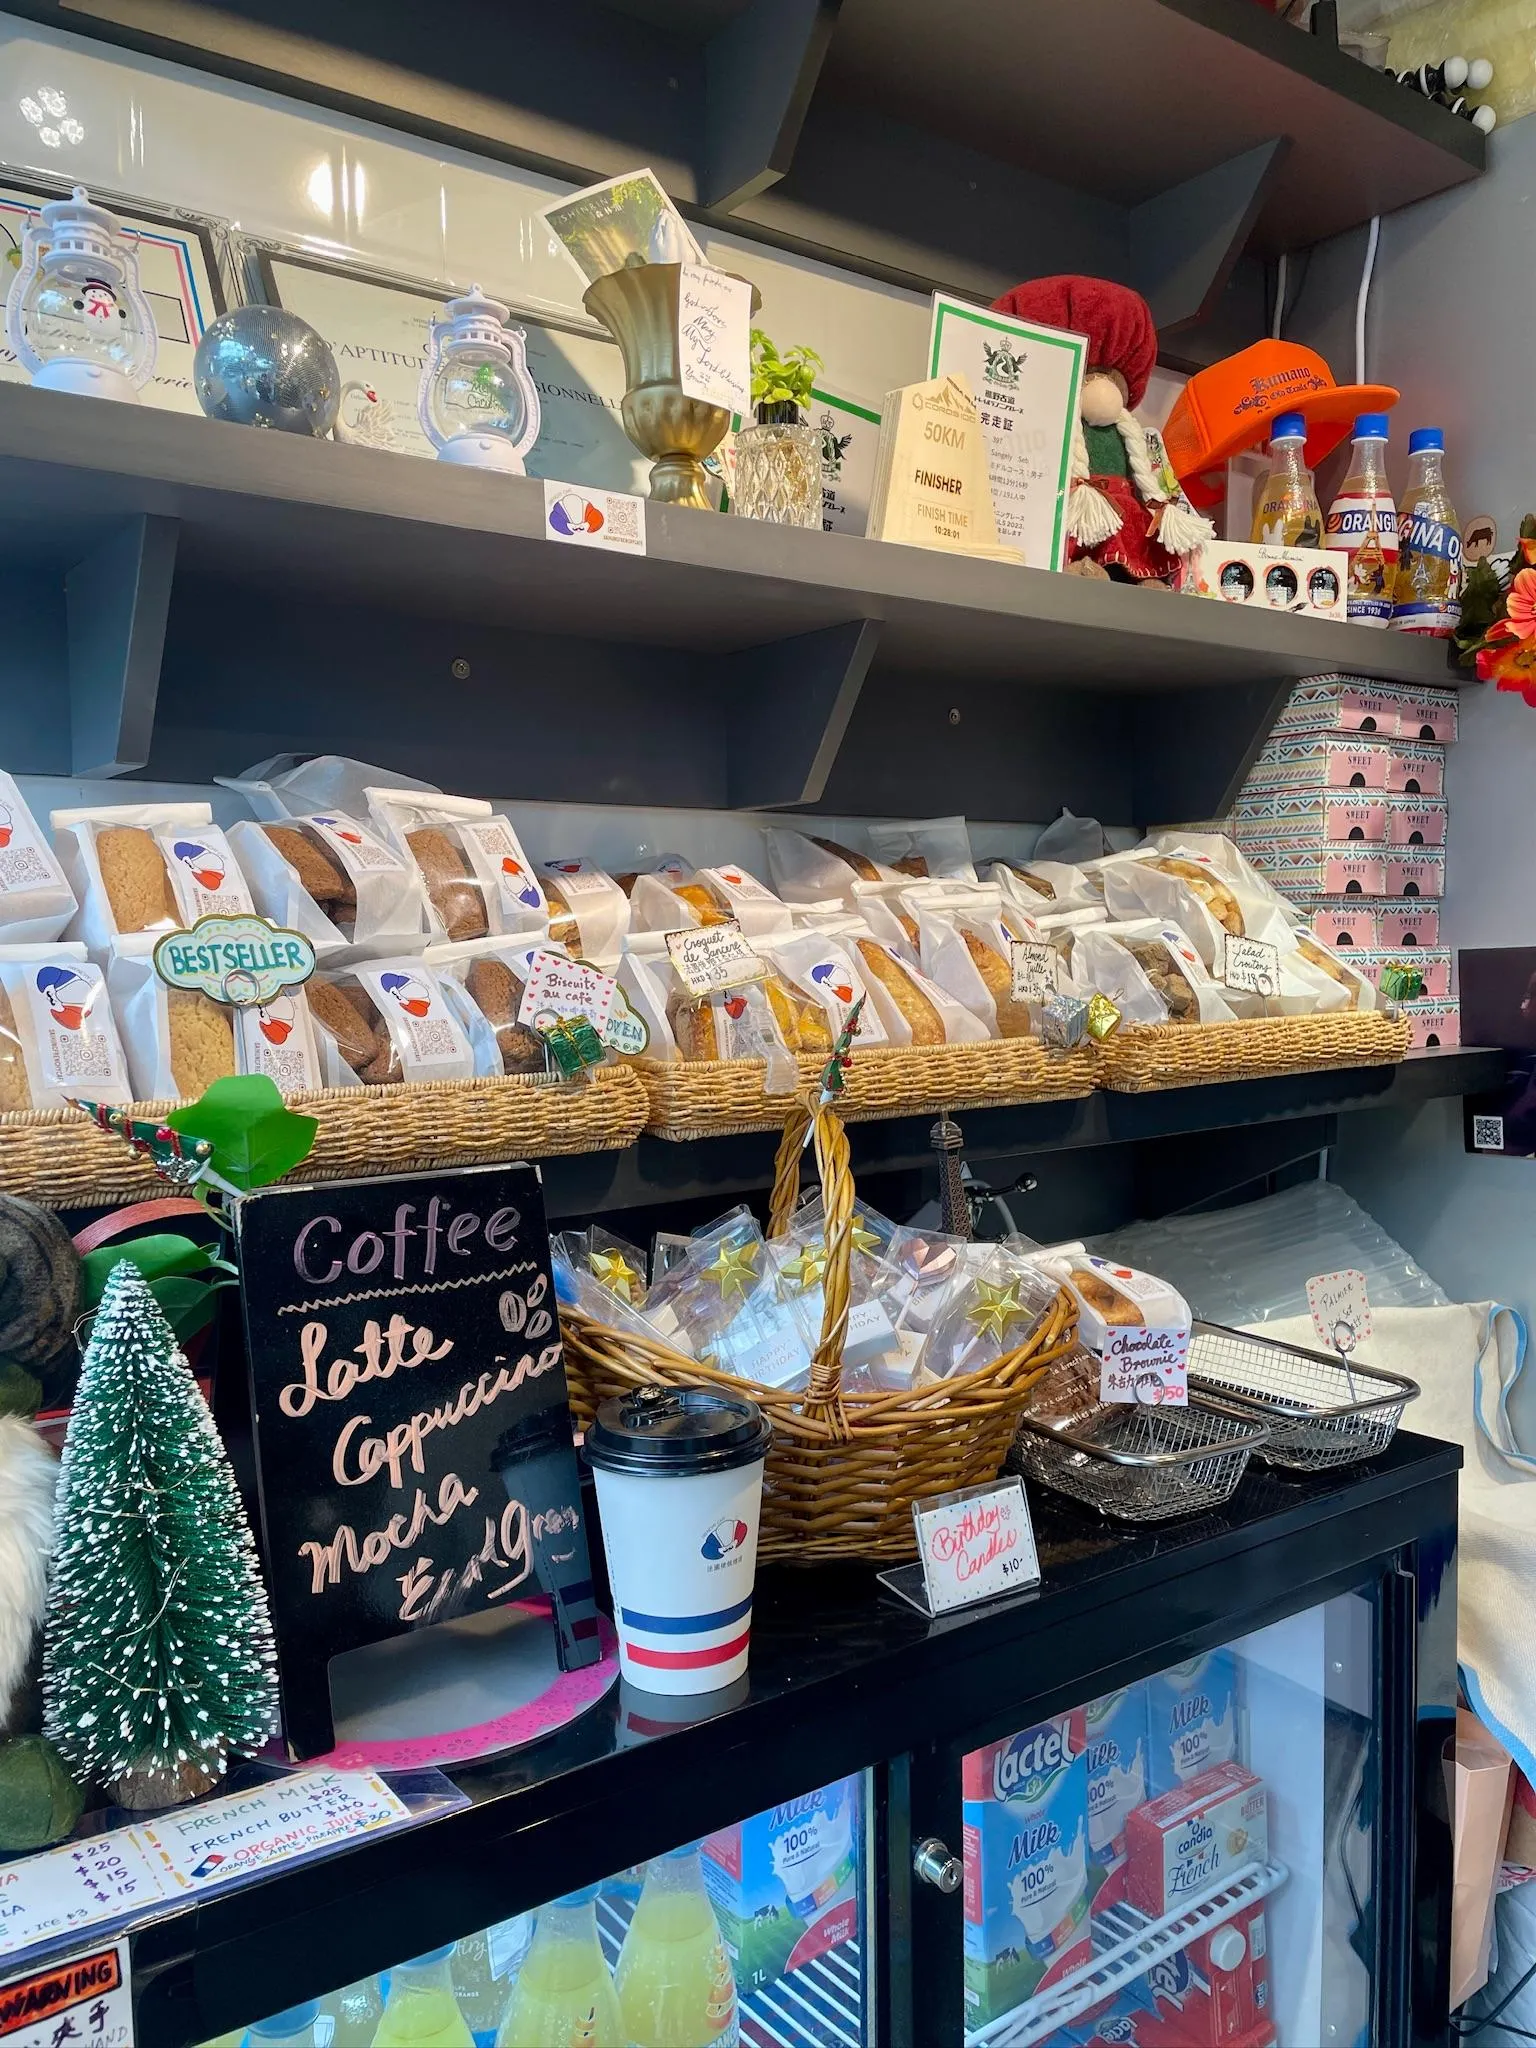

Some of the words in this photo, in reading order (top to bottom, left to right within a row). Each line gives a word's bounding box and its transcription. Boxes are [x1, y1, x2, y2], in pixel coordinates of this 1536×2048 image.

[980, 412, 1014, 432] 完走証
[924, 420, 966, 451] 50KM
[914, 469, 963, 496] FINISHER
[917, 503, 946, 524] FINISH
[948, 510, 968, 528] TIME
[1342, 512, 1397, 534] ORANGI
[934, 524, 960, 540] 10:28:01
[1359, 700, 1382, 711] SWEET
[1416, 709, 1438, 720] SWEET
[1347, 756, 1372, 766] SWEET
[1403, 764, 1425, 773] SWEET
[1346, 811, 1369, 820] SWEET
[1407, 815, 1429, 825] SWEET
[1343, 864, 1366, 873] SWEET
[1401, 867, 1424, 877] SWEET
[1332, 917, 1356, 926] SWEET
[1399, 917, 1423, 927] SWEET
[683, 950, 699, 963] de
[545, 973, 597, 991] Biscuits
[541, 989, 561, 999] au
[1422, 1018, 1444, 1027] SWEET
[293, 1195, 521, 1284] Coffee
[1111, 1332, 1175, 1356] Chocolate
[278, 1313, 455, 1418] Latte
[1118, 1350, 1179, 1374] Brownie
[332, 1341, 564, 1489] Cappuccino
[931, 1505, 1001, 1562] Birthday
[956, 1529, 1018, 1582] Candles
[1169, 1695, 1210, 1735] Milk
[1181, 1731, 1208, 1756] 100%
[1088, 1779, 1114, 1805] 00%
[176, 1799, 267, 1836] FRENCH
[277, 1774, 343, 1802] MILK
[324, 1800, 364, 1819] $40
[769, 1790, 825, 1831] Milk
[189, 1819, 272, 1855] FRENCH
[279, 1792, 356, 1824] BUTTER
[354, 1809, 392, 1828] $30
[234, 1824, 317, 1861] ORGANIC
[322, 1808, 369, 1830] JUICE
[783, 1825, 818, 1854] 100%
[1008, 1820, 1061, 1870] Milk
[1178, 1827, 1213, 1854] candia
[1021, 1863, 1054, 1893] 100%
[823, 1918, 850, 1938] Whole
[752, 1968, 767, 1985] 1L
